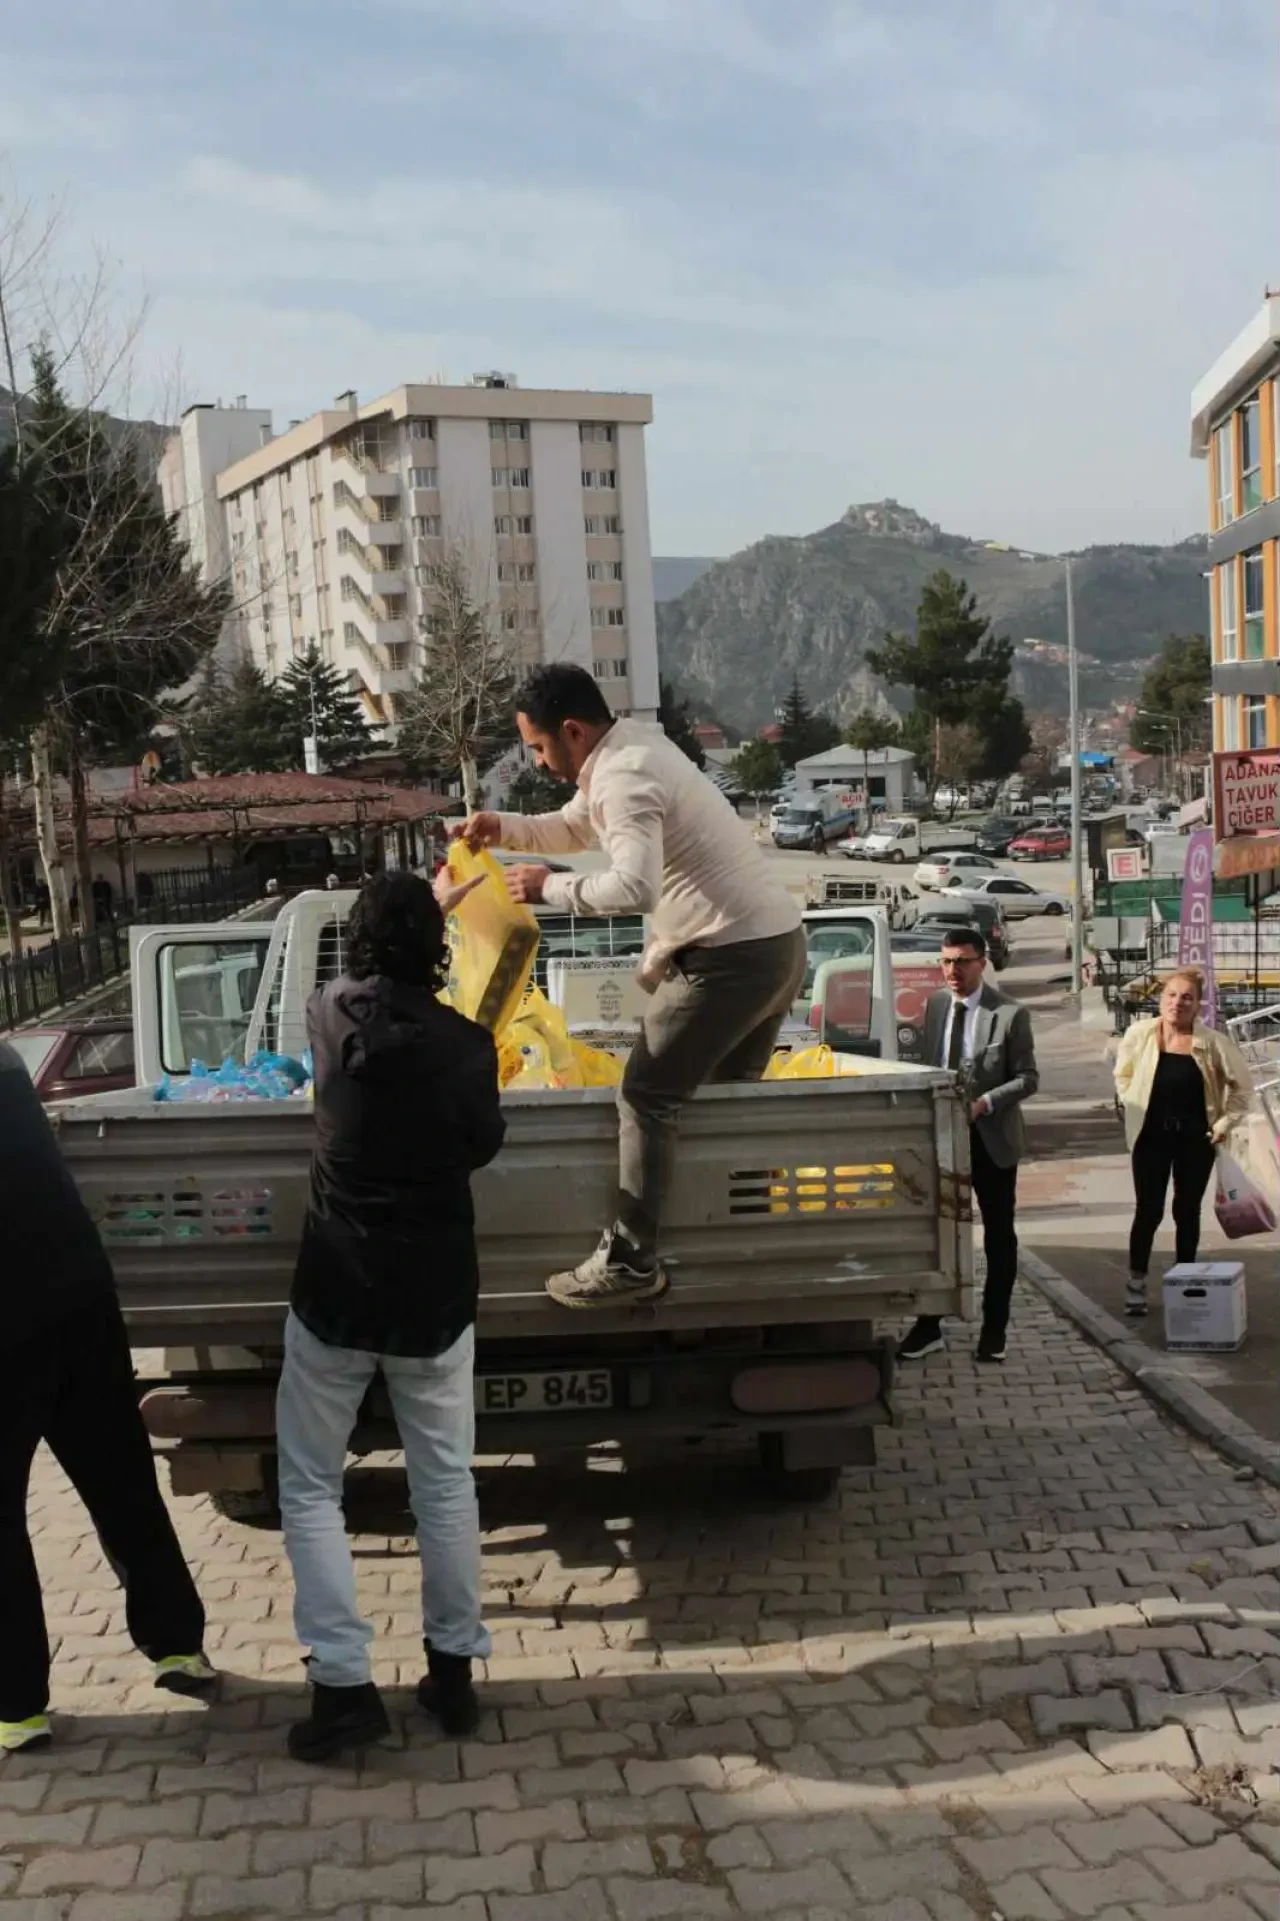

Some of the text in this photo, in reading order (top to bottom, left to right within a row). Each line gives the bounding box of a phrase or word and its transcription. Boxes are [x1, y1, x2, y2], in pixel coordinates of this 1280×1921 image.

[1225, 763, 1280, 780] ADANA
[1226, 783, 1278, 804] TAVUK
[485, 1373, 609, 1409] EP 845
